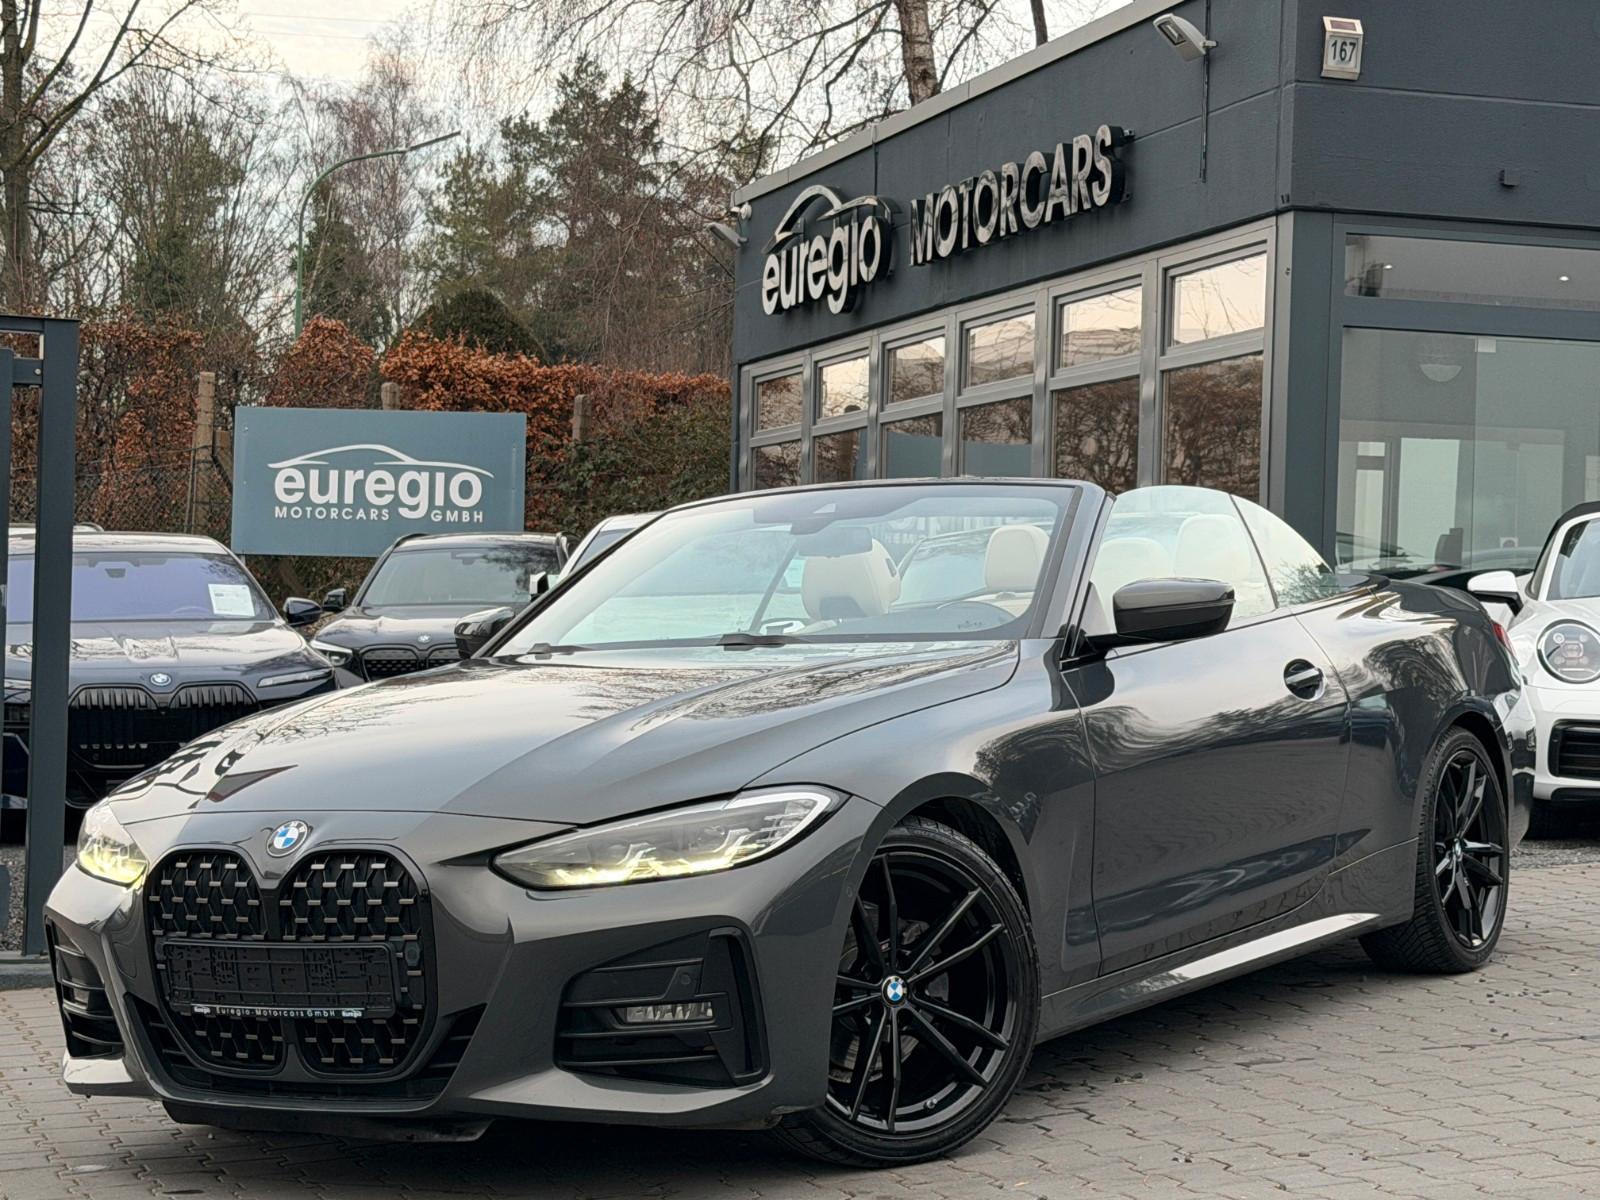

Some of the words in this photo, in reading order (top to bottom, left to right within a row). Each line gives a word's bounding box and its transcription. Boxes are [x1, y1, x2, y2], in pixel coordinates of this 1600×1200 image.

[1331, 39, 1357, 62] 167
[762, 215, 881, 315] euregio
[909, 124, 1112, 266] MOTORCARS
[274, 467, 482, 519] euregio
[275, 506, 390, 520] MOTORCARS
[430, 511, 484, 523] GMBH
[306, 1009, 335, 1017] GmbH
